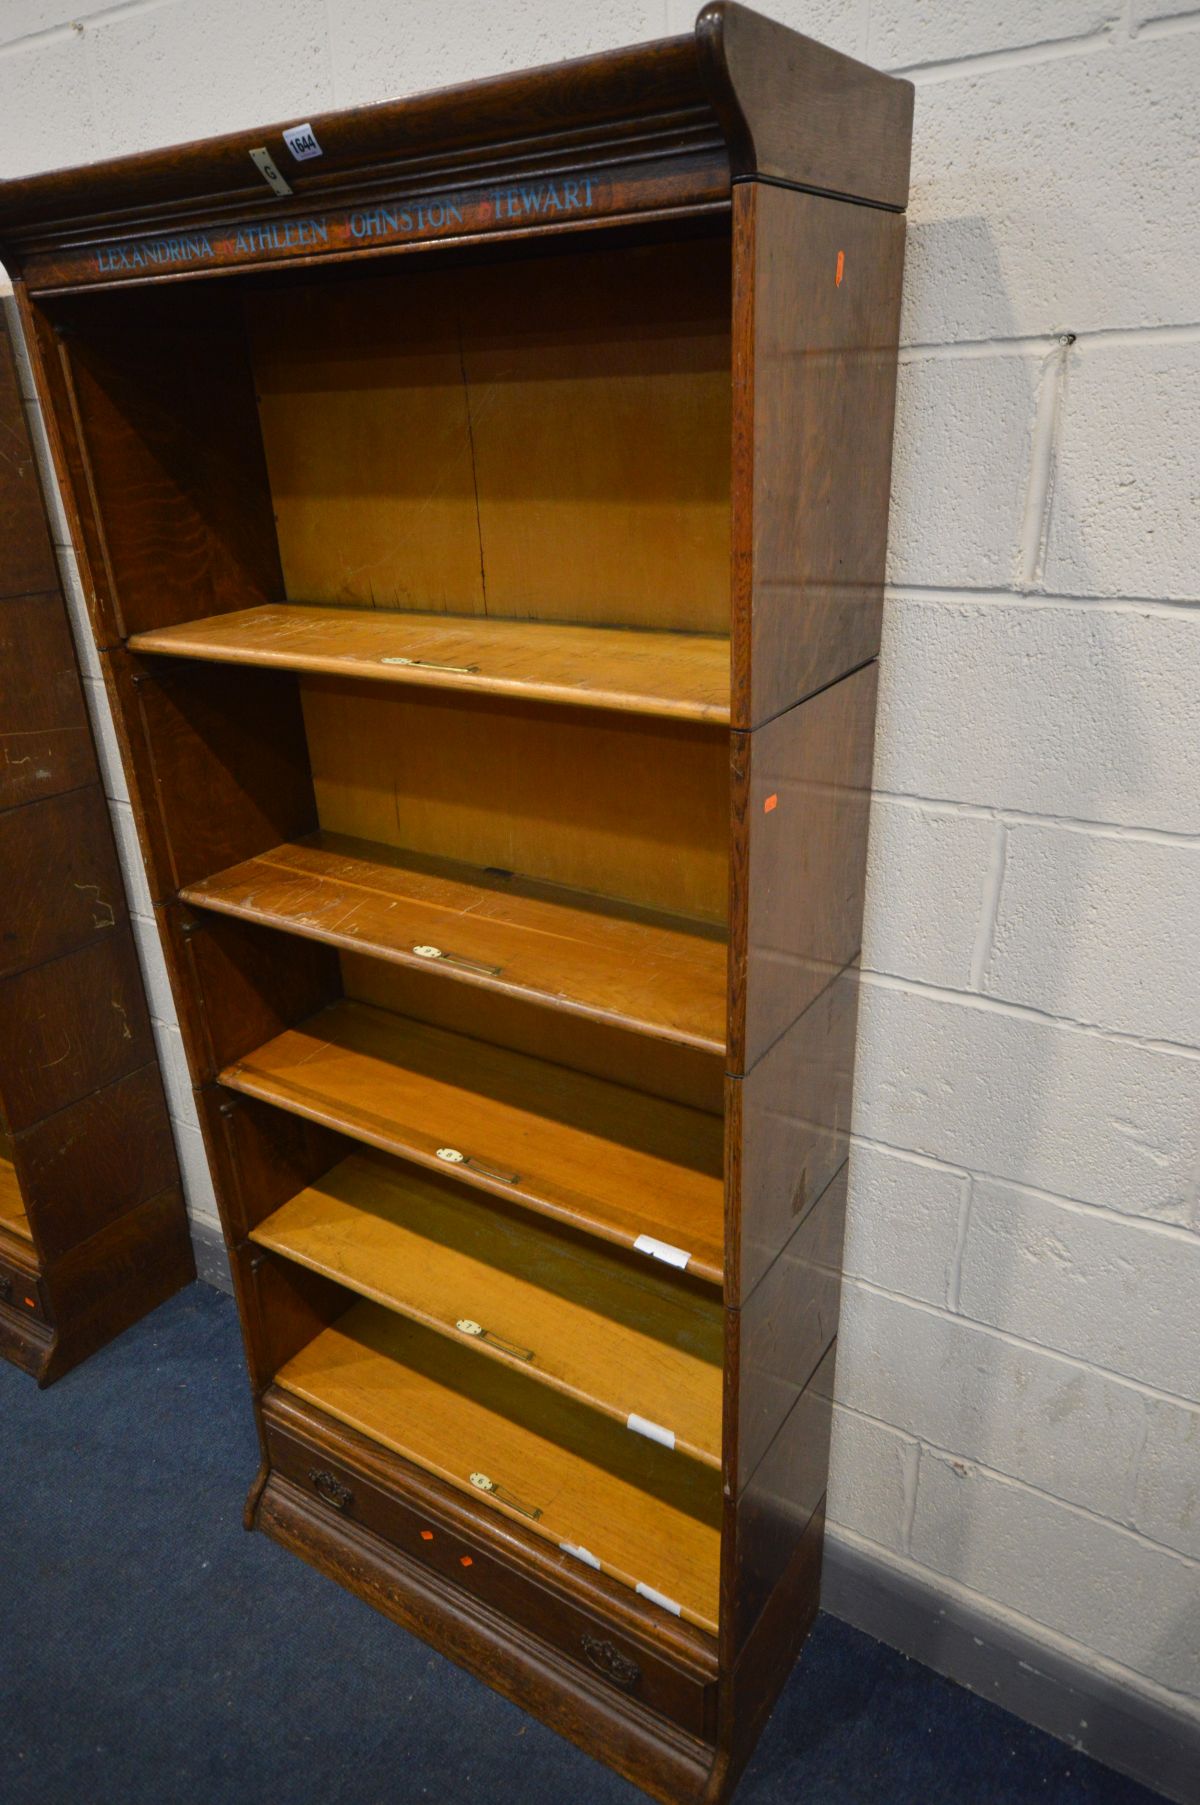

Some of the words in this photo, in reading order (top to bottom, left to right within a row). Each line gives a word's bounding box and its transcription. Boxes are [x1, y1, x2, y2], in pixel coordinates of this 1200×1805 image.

[289, 134, 317, 154] 1644
[264, 165, 277, 180] G
[90, 235, 215, 273] LEXANDRINA
